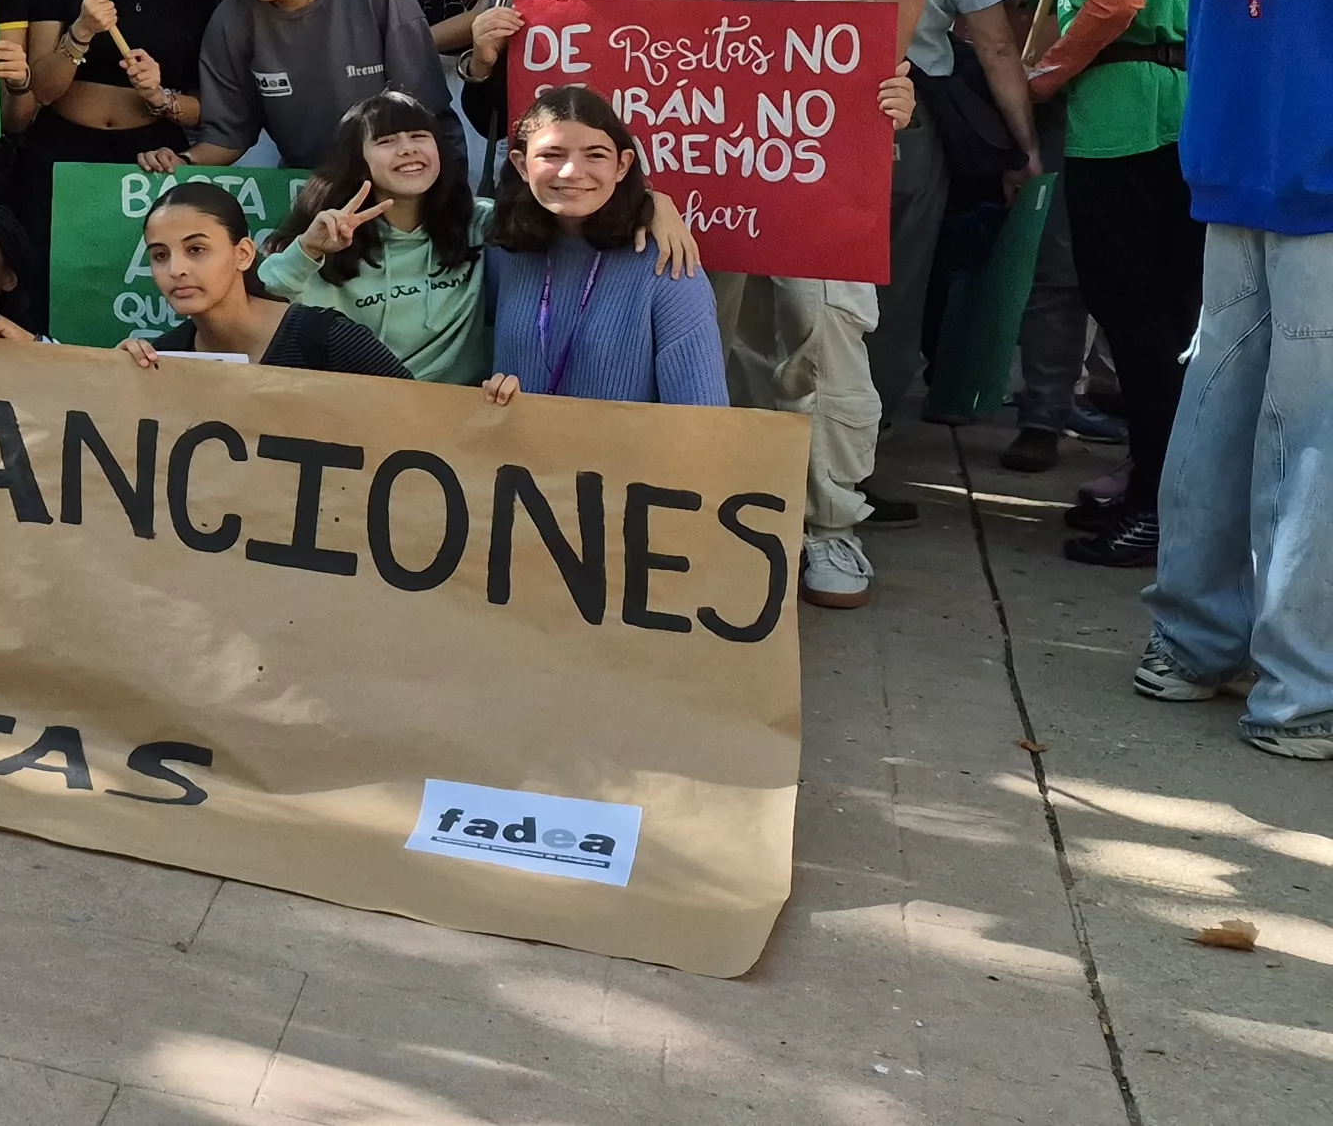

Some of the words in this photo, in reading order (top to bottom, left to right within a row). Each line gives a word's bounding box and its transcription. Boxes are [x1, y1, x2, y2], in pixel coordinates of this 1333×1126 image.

[523, 23, 592, 73] DE
[609, 16, 775, 86] Rositas
[785, 23, 861, 74] NO
[757, 89, 835, 139] NO
[682, 189, 760, 239] har
[438, 808, 617, 857] fadea
